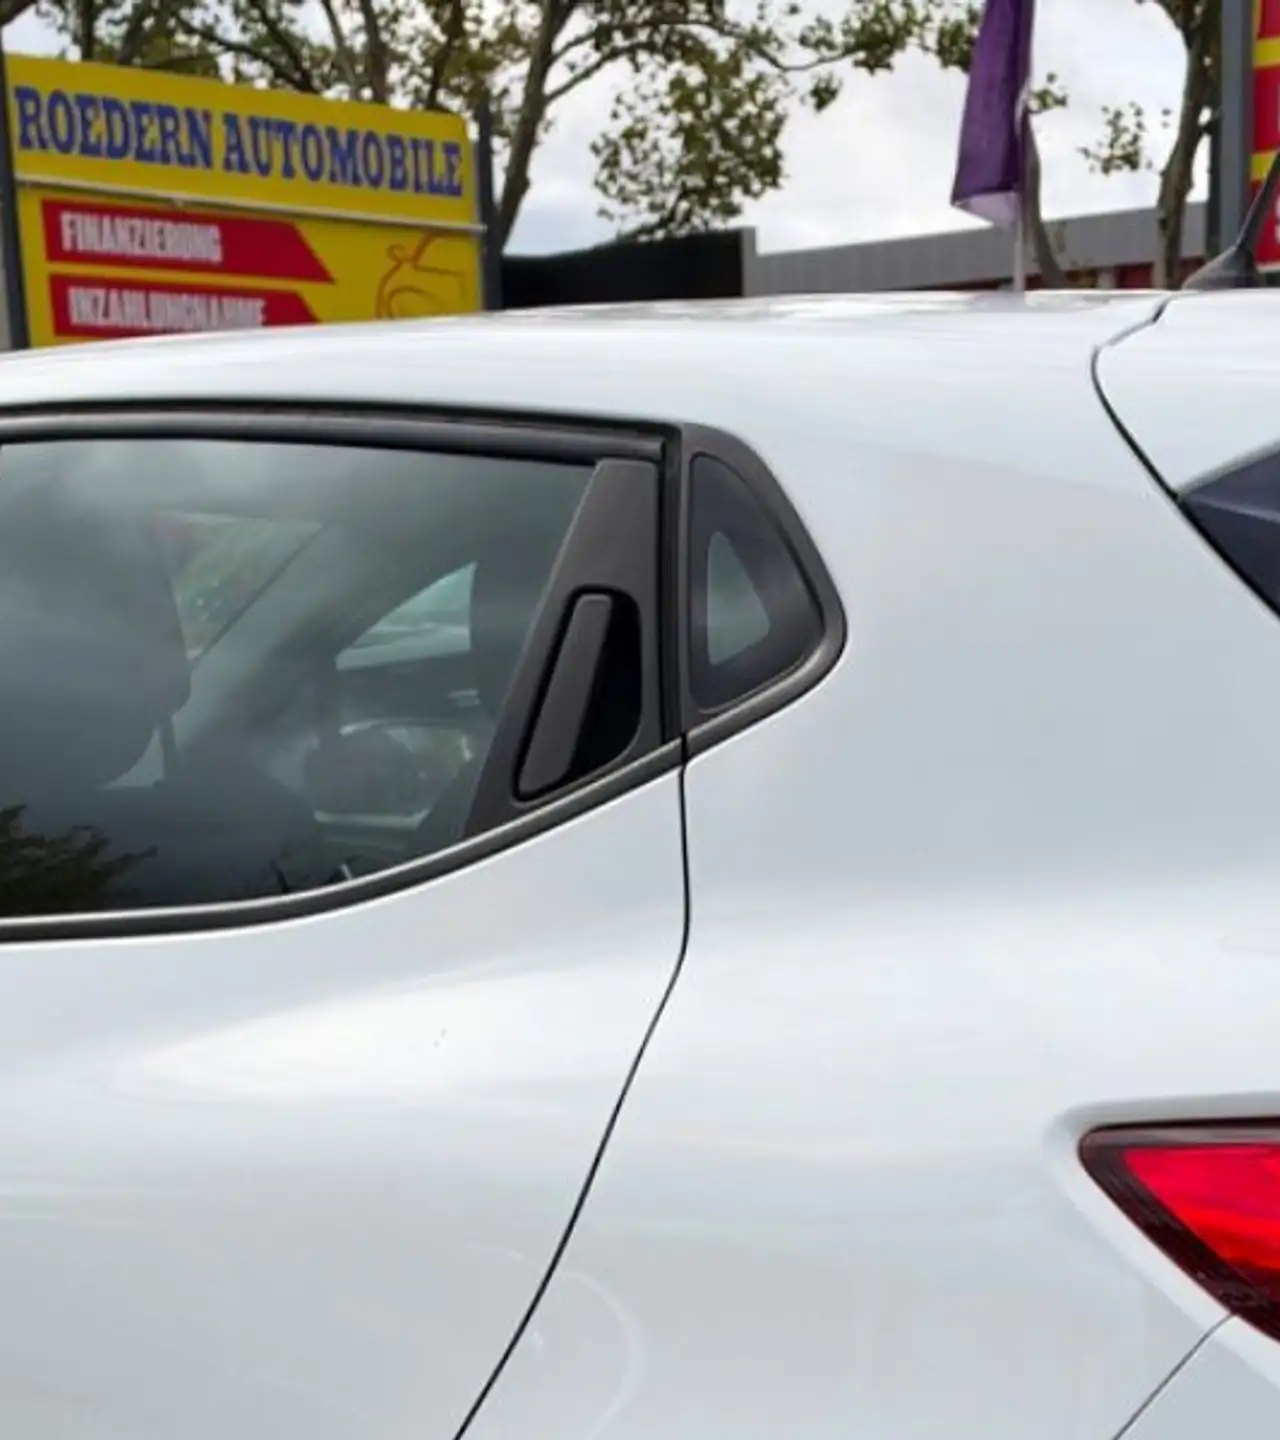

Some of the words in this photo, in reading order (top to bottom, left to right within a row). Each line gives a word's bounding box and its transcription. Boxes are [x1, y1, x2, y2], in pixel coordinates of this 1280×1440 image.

[14, 86, 213, 169] ROEDERN
[222, 112, 462, 196] AUTOMOBILE
[60, 211, 223, 263] FINANZIERUNG
